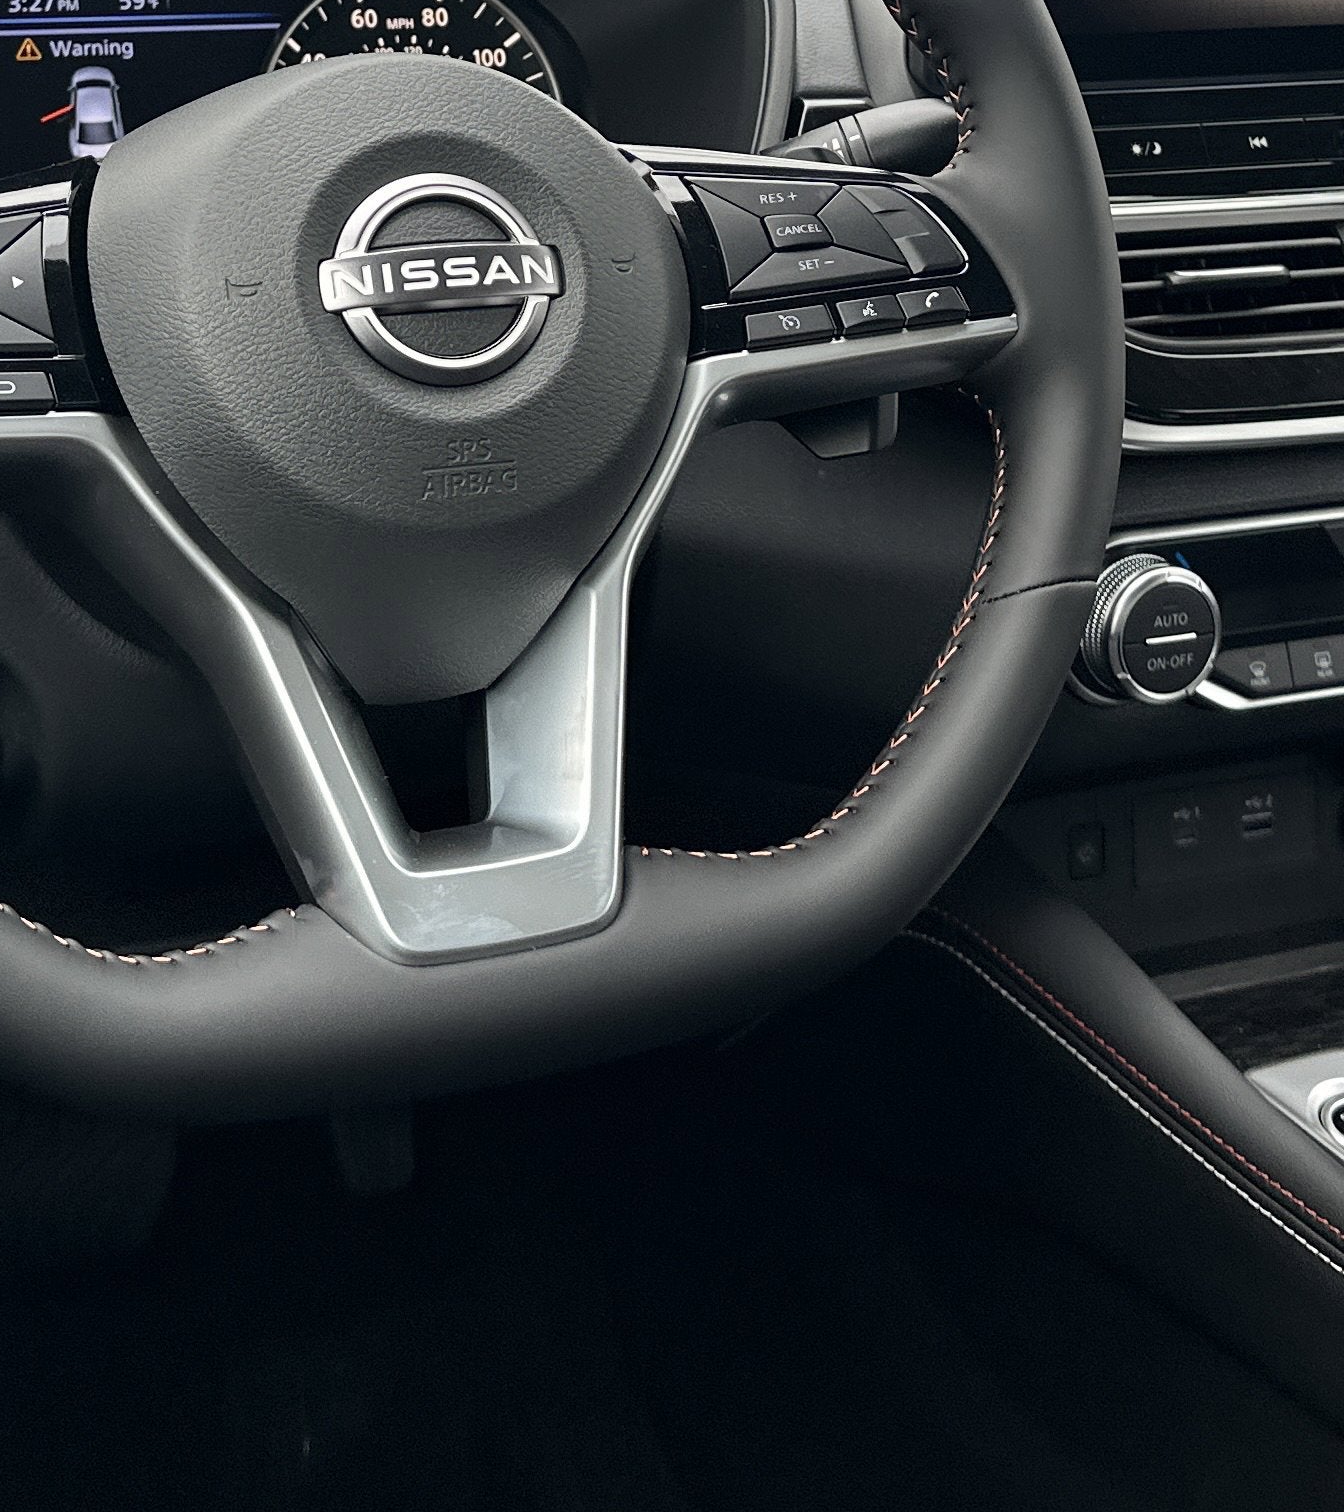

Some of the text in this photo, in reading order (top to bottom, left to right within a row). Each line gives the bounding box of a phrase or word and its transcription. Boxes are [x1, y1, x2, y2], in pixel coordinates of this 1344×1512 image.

[349, 8, 378, 29] 60
[385, 17, 415, 31] MPH
[421, 6, 449, 28] 80
[49, 38, 135, 60] Warning
[471, 47, 507, 68] 100
[759, 192, 785, 206] RES
[775, 222, 824, 238] CANCEL
[798, 257, 821, 272] SET
[332, 254, 555, 300] NISSAN
[420, 467, 519, 501] AIRBAG
[1153, 611, 1189, 629] AUTO
